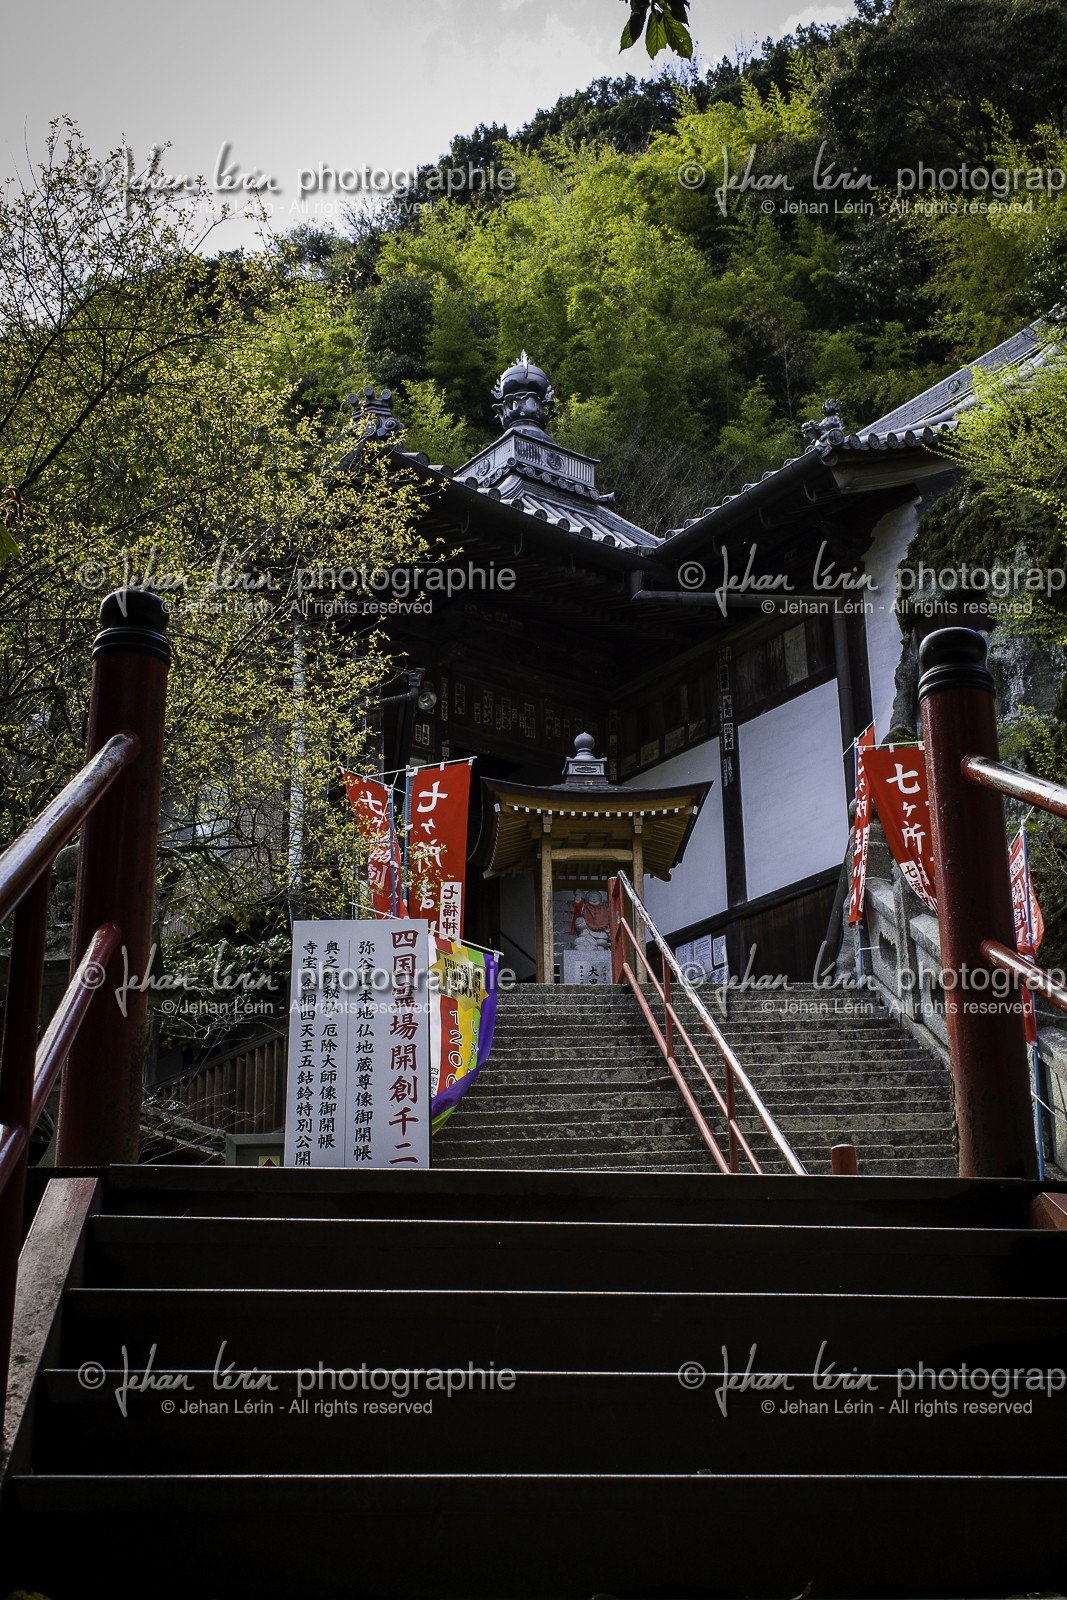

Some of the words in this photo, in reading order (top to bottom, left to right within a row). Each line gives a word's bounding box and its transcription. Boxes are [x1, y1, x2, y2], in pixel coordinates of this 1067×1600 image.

[353, 941, 376, 1162] 弥谷山本地仏地蔵尊像御開帳
[388, 929, 419, 1166] 四国霊場開創千二
